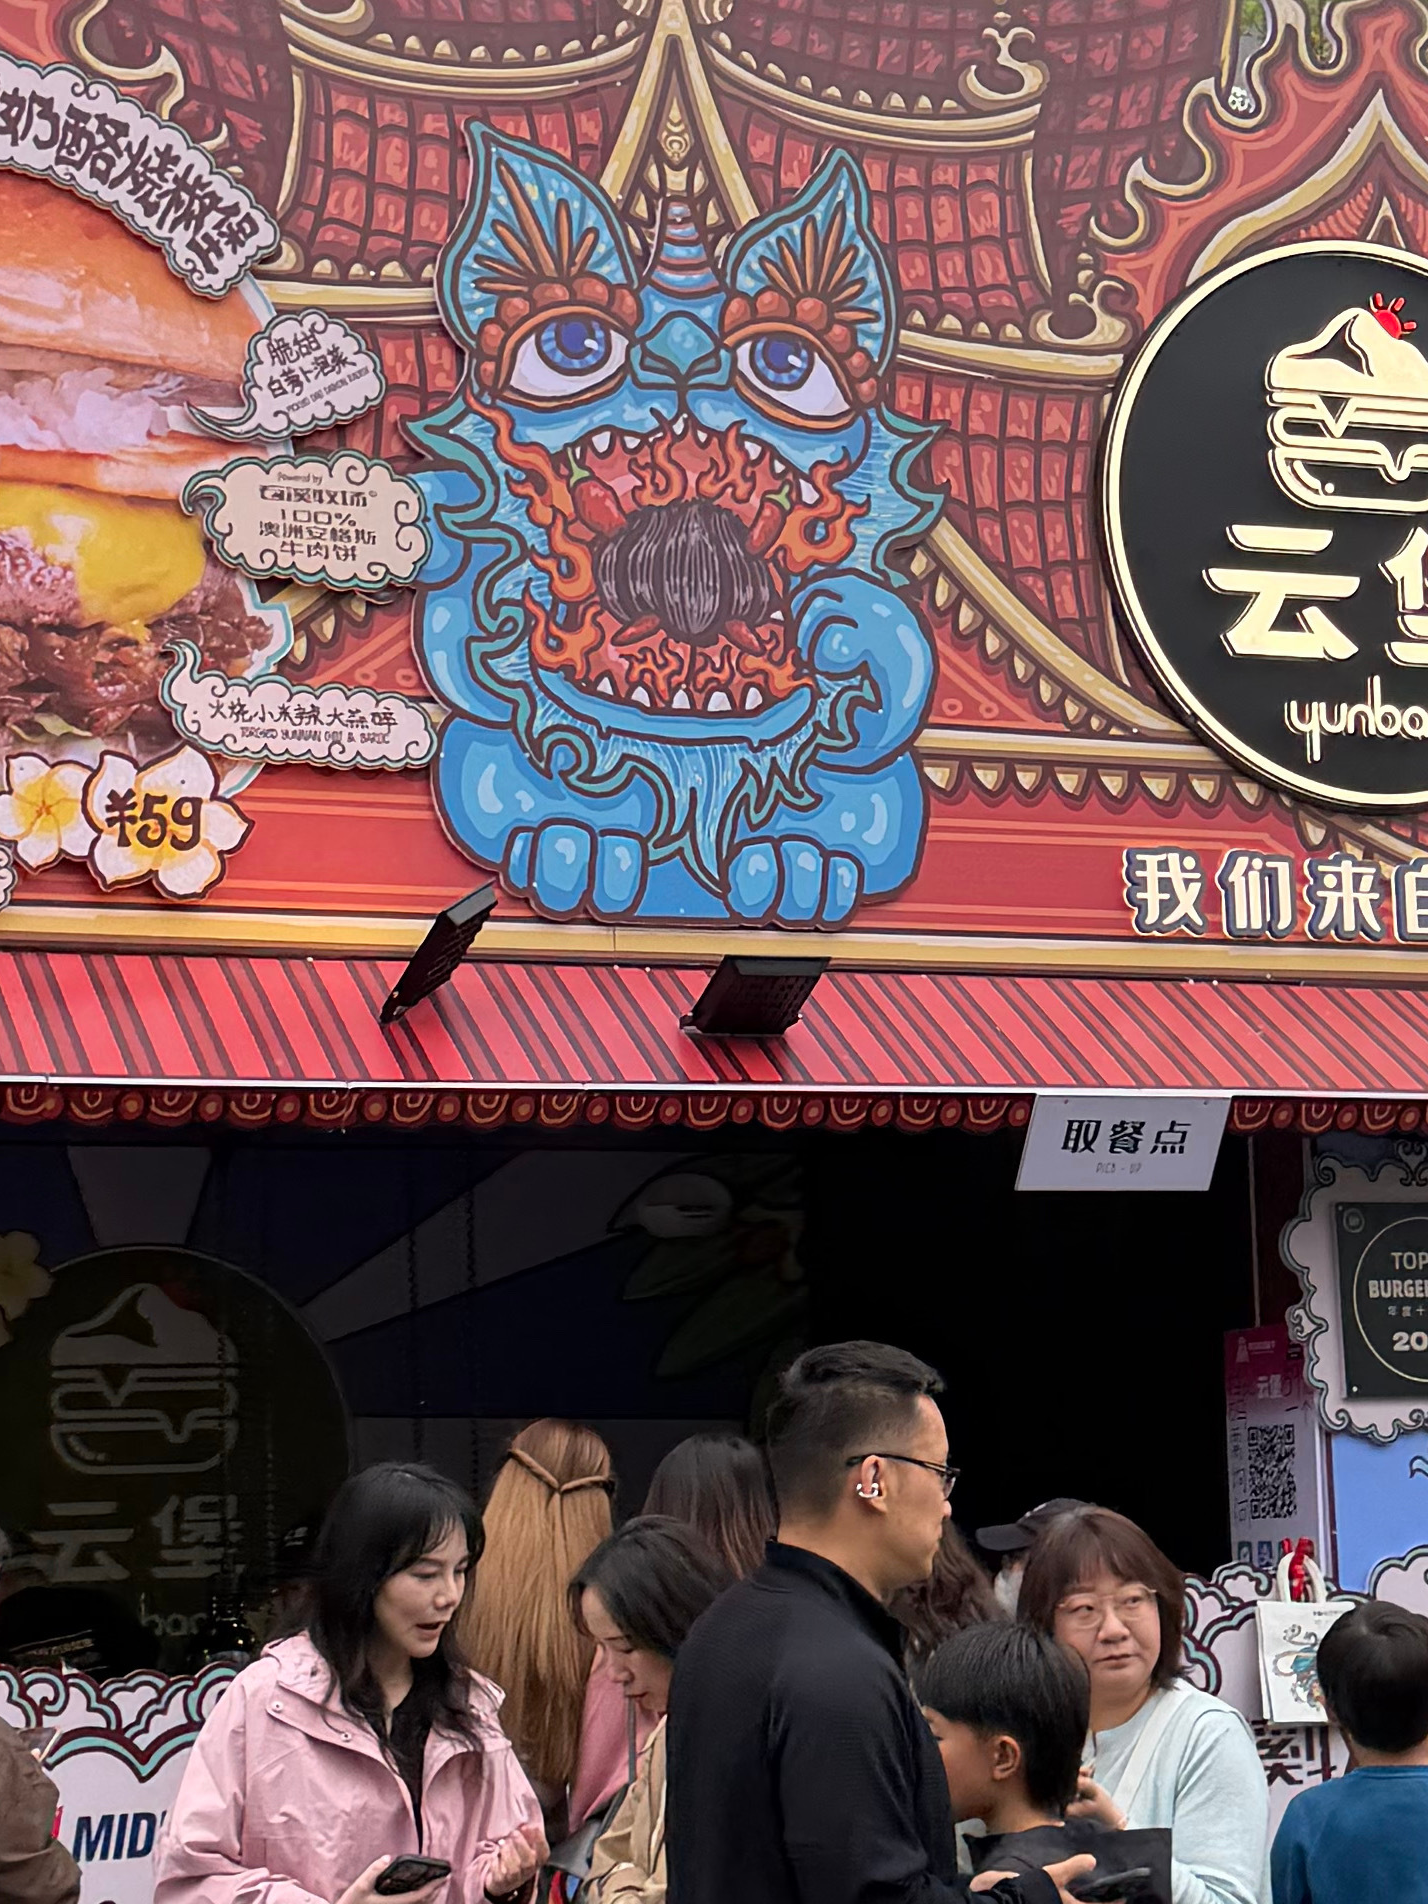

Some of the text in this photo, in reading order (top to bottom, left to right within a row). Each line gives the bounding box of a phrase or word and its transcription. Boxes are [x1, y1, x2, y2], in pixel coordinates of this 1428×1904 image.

[259, 520, 377, 545] 澳洲安格斯
[280, 509, 357, 527] 100%
[279, 540, 357, 562] 牛肉饼
[105, 788, 204, 851] ¥59
[1061, 1119, 1192, 1154] 取餐点
[29, 1495, 246, 1583] 云堡
[73, 1809, 168, 1863] MID
